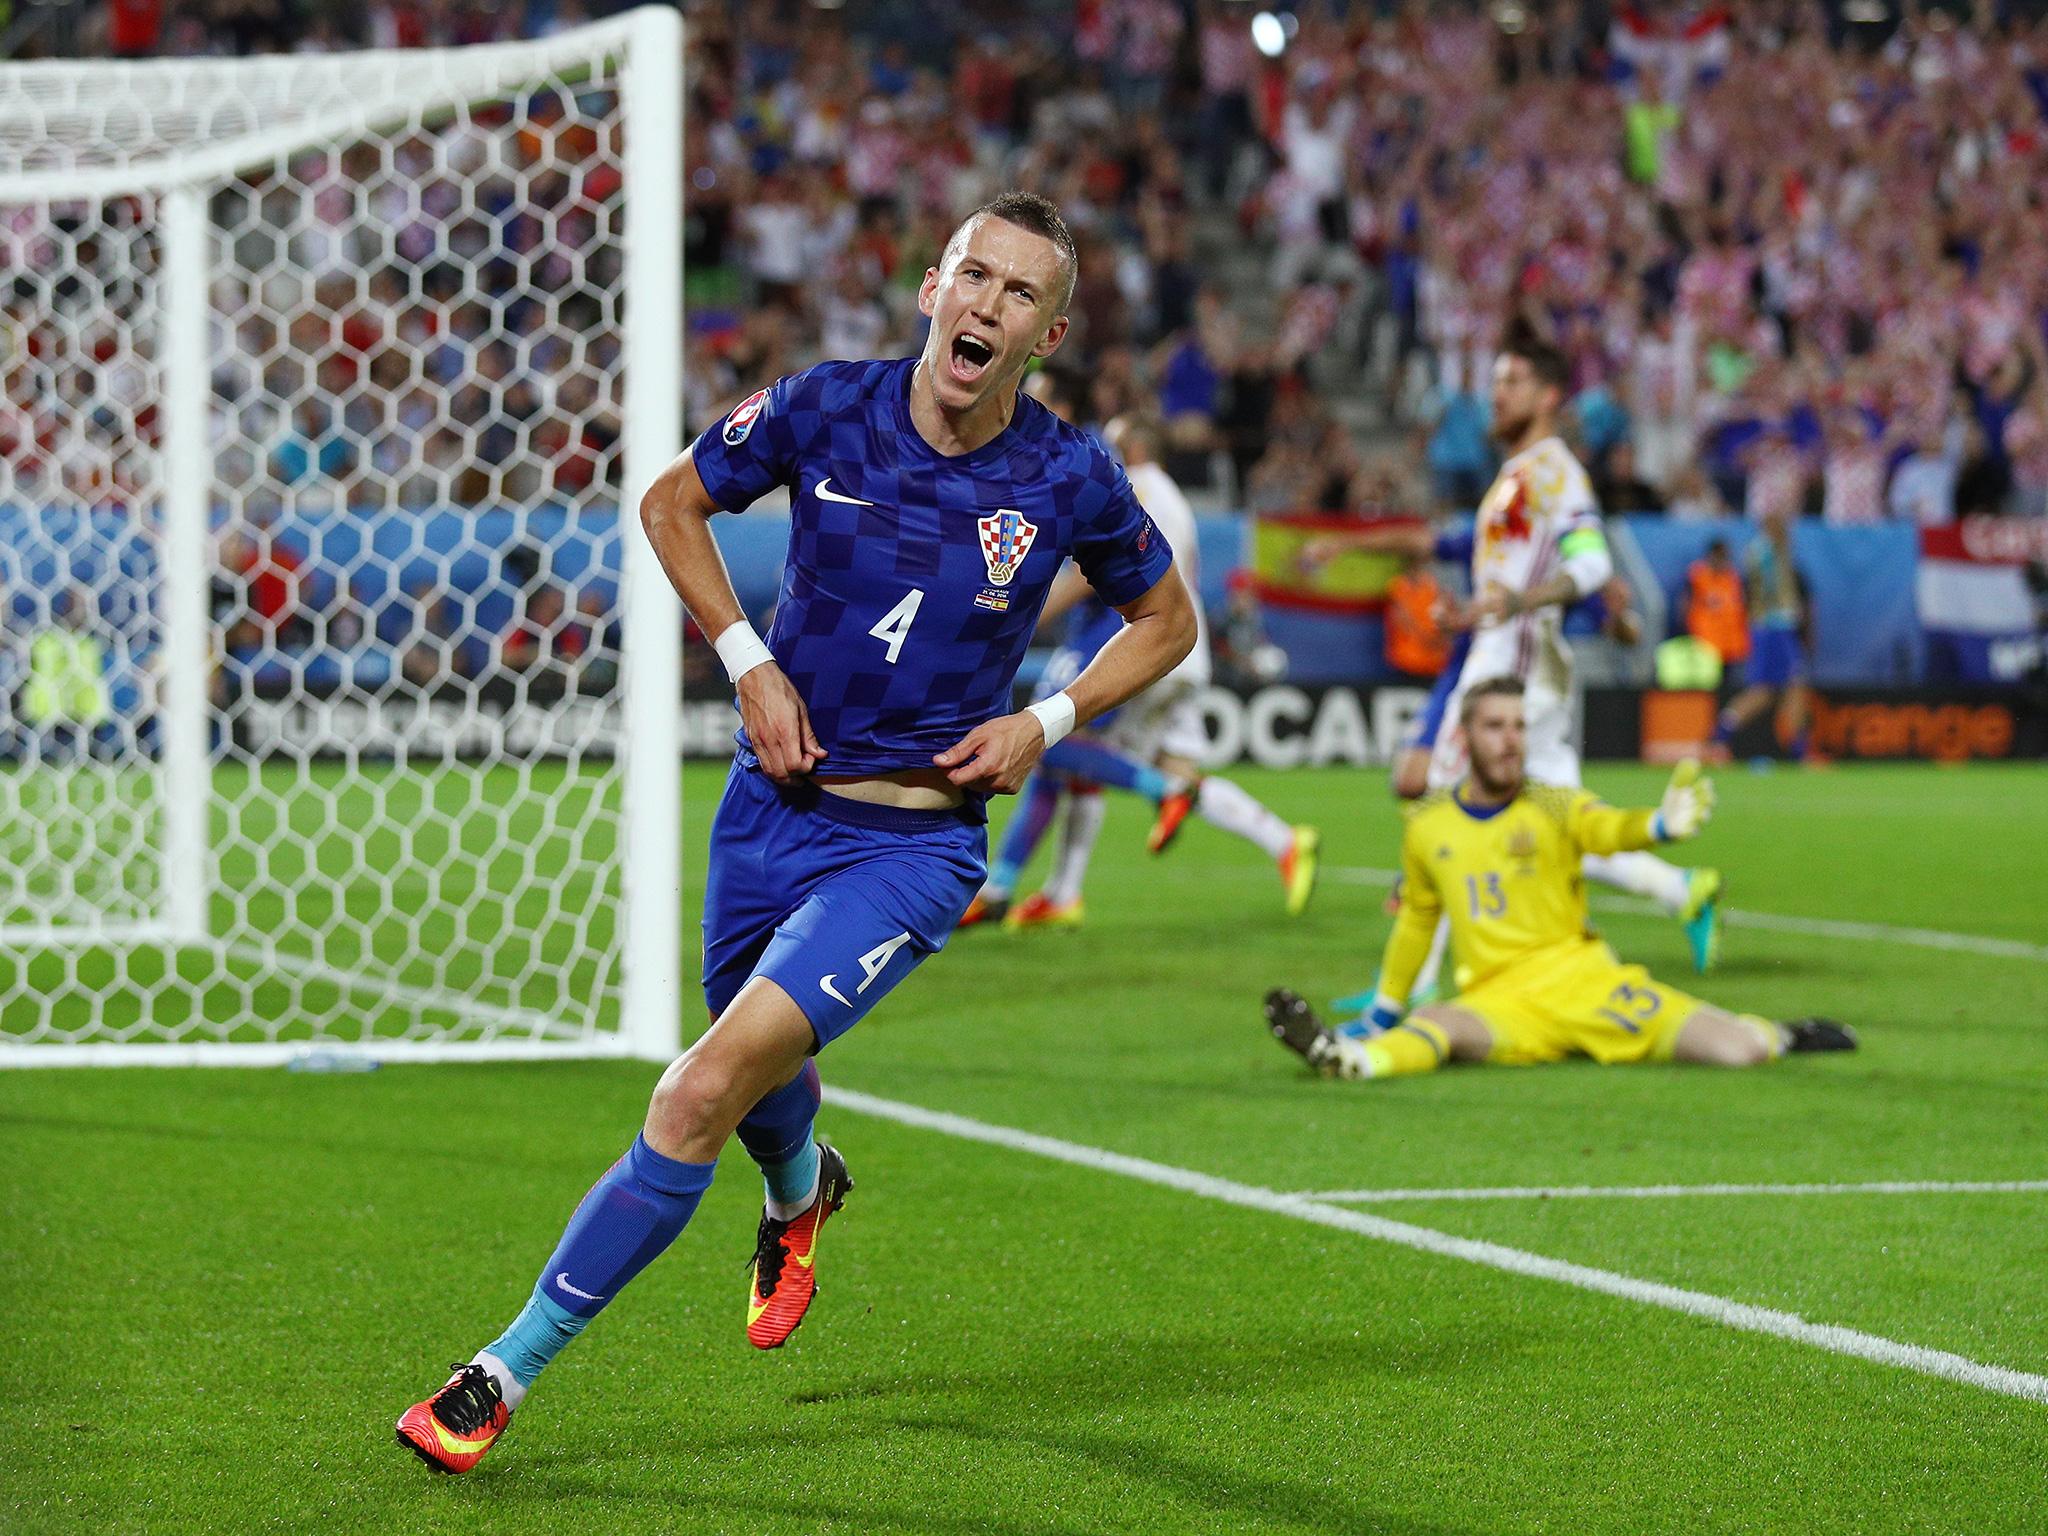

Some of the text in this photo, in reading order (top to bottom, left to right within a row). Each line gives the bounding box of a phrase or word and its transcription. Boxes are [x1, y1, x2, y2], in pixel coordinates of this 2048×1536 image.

[868, 588, 925, 664] 4
[1465, 872, 1507, 922] 13
[857, 931, 912, 995] 4
[1596, 981, 1662, 1034] 13
